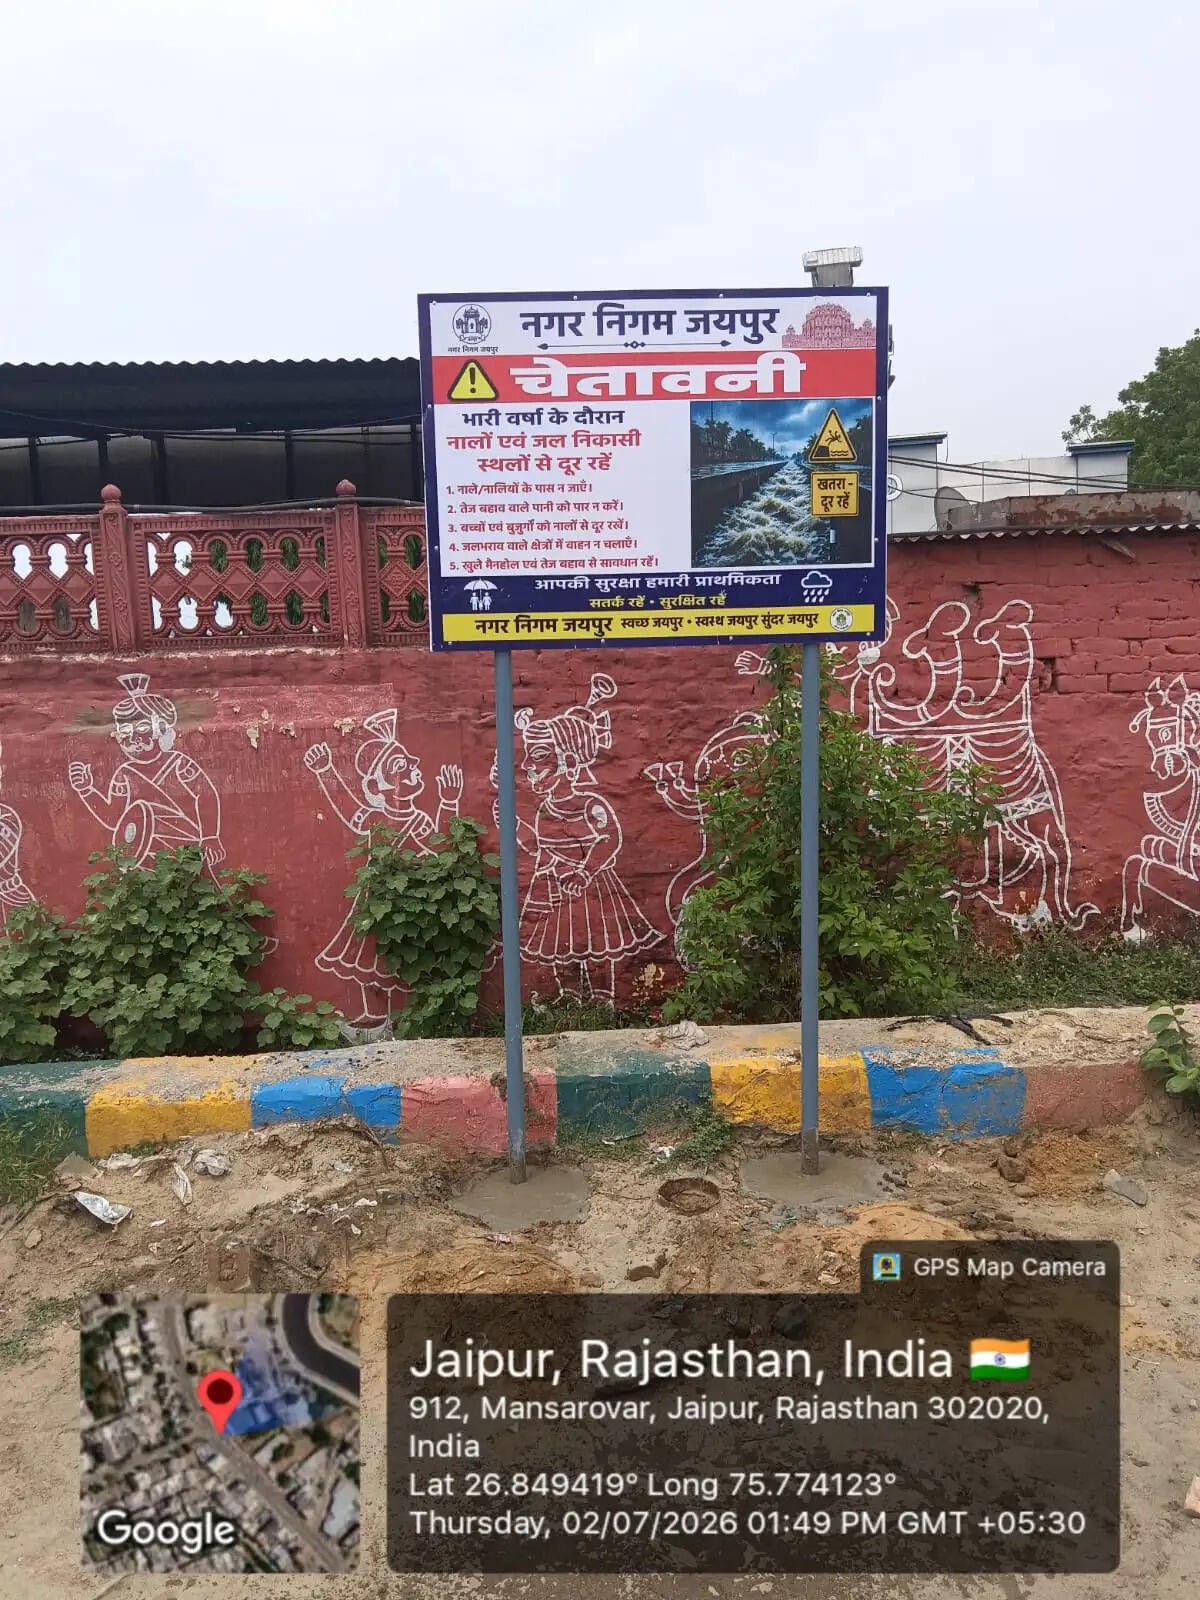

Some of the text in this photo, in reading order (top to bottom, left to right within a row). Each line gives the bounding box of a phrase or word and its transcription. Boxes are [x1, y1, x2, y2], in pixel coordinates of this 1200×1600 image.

[520, 303, 779, 344] नगर निगम जयपुर
[510, 352, 806, 399] चेतावनी
[462, 406, 625, 426] भारी वर्षा के दौरान
[447, 429, 641, 449] नालों एवं जल निकासी
[478, 452, 612, 475] स्थलों से दूर रहें
[446, 486, 454, 495] 1.
[522, 483, 532, 493] के
[535, 485, 555, 493] पास
[558, 485, 565, 493] न
[817, 478, 846, 490] खतरा
[448, 505, 456, 514] 2.
[459, 502, 476, 513] तेज
[479, 504, 506, 513] बहाव
[508, 501, 529, 512] वाले
[532, 501, 553, 512] पानी
[557, 500, 570, 512] को
[573, 503, 589, 511] पार
[592, 503, 599, 511] न
[820, 491, 850, 512] दूर रहें
[448, 525, 457, 533] 3.
[460, 521, 486, 532] बच्चों
[488, 522, 503, 532] एवं
[536, 520, 551, 531] को
[553, 520, 578, 531] नालों
[579, 520, 589, 530] से
[592, 521, 605, 534] दूर
[449, 544, 458, 552] 4.
[462, 542, 504, 551] जलभराव
[507, 540, 528, 551] वाले
[556, 538, 564, 550] में
[566, 541, 592, 549] वाहन
[594, 541, 600, 549] न
[449, 561, 459, 570] 5.
[462, 558, 482, 573] खुले
[522, 559, 538, 569] एवं
[541, 558, 557, 569] तेज
[560, 560, 586, 568] बहाव
[588, 557, 597, 568] से
[600, 559, 638, 568] सावधान
[534, 572, 781, 592] आपकी सुरक्षा हमारी प्राथमिकता
[589, 591, 727, 609] सतर्क रहें सुरक्षित रहें
[475, 618, 510, 635] नगर
[513, 615, 559, 633] निगम
[563, 617, 614, 636] जयपुर
[620, 616, 650, 630] स्वच्छ
[652, 615, 683, 631] जयपुर
[694, 615, 725, 628] स्वस्थ
[728, 615, 758, 629] जयपुर
[761, 612, 785, 628] सुंदर
[788, 614, 818, 628] जयपुर
